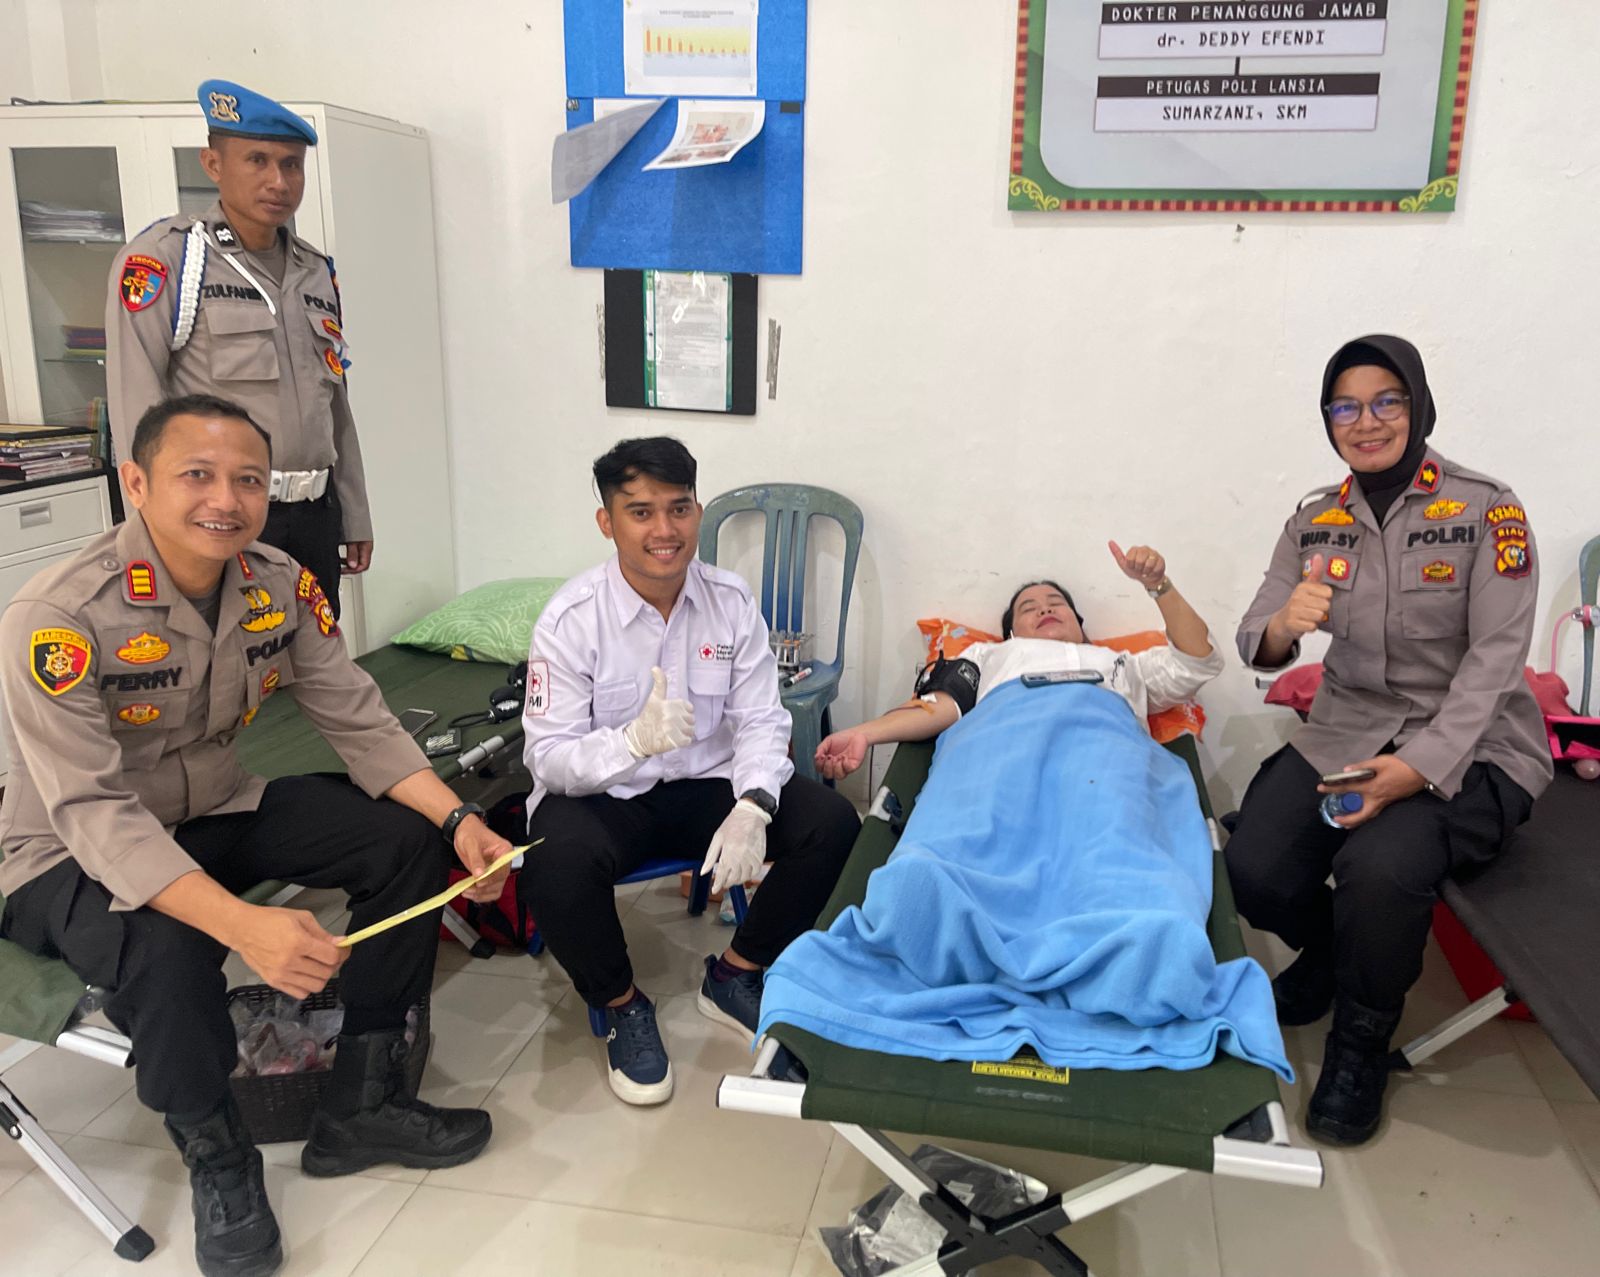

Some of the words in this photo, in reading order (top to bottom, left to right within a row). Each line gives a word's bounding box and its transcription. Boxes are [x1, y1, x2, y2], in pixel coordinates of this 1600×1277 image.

[1111, 5, 1177, 21] DOKTER
[1191, 3, 1305, 20] PENANGGUNG
[1318, 2, 1377, 18] JAWAB
[1157, 33, 1185, 48] dr.
[1199, 31, 1251, 47] DEDDY
[1261, 29, 1326, 46] EFENDI
[1146, 80, 1210, 95] PETUGAS
[1221, 79, 1257, 94] POLI
[1268, 78, 1326, 93] LANSIA
[1276, 104, 1308, 120] SKM
[1407, 526, 1475, 547] POLRI
[1497, 527, 1524, 537] RIAU
[100, 666, 183, 692] FERRY
